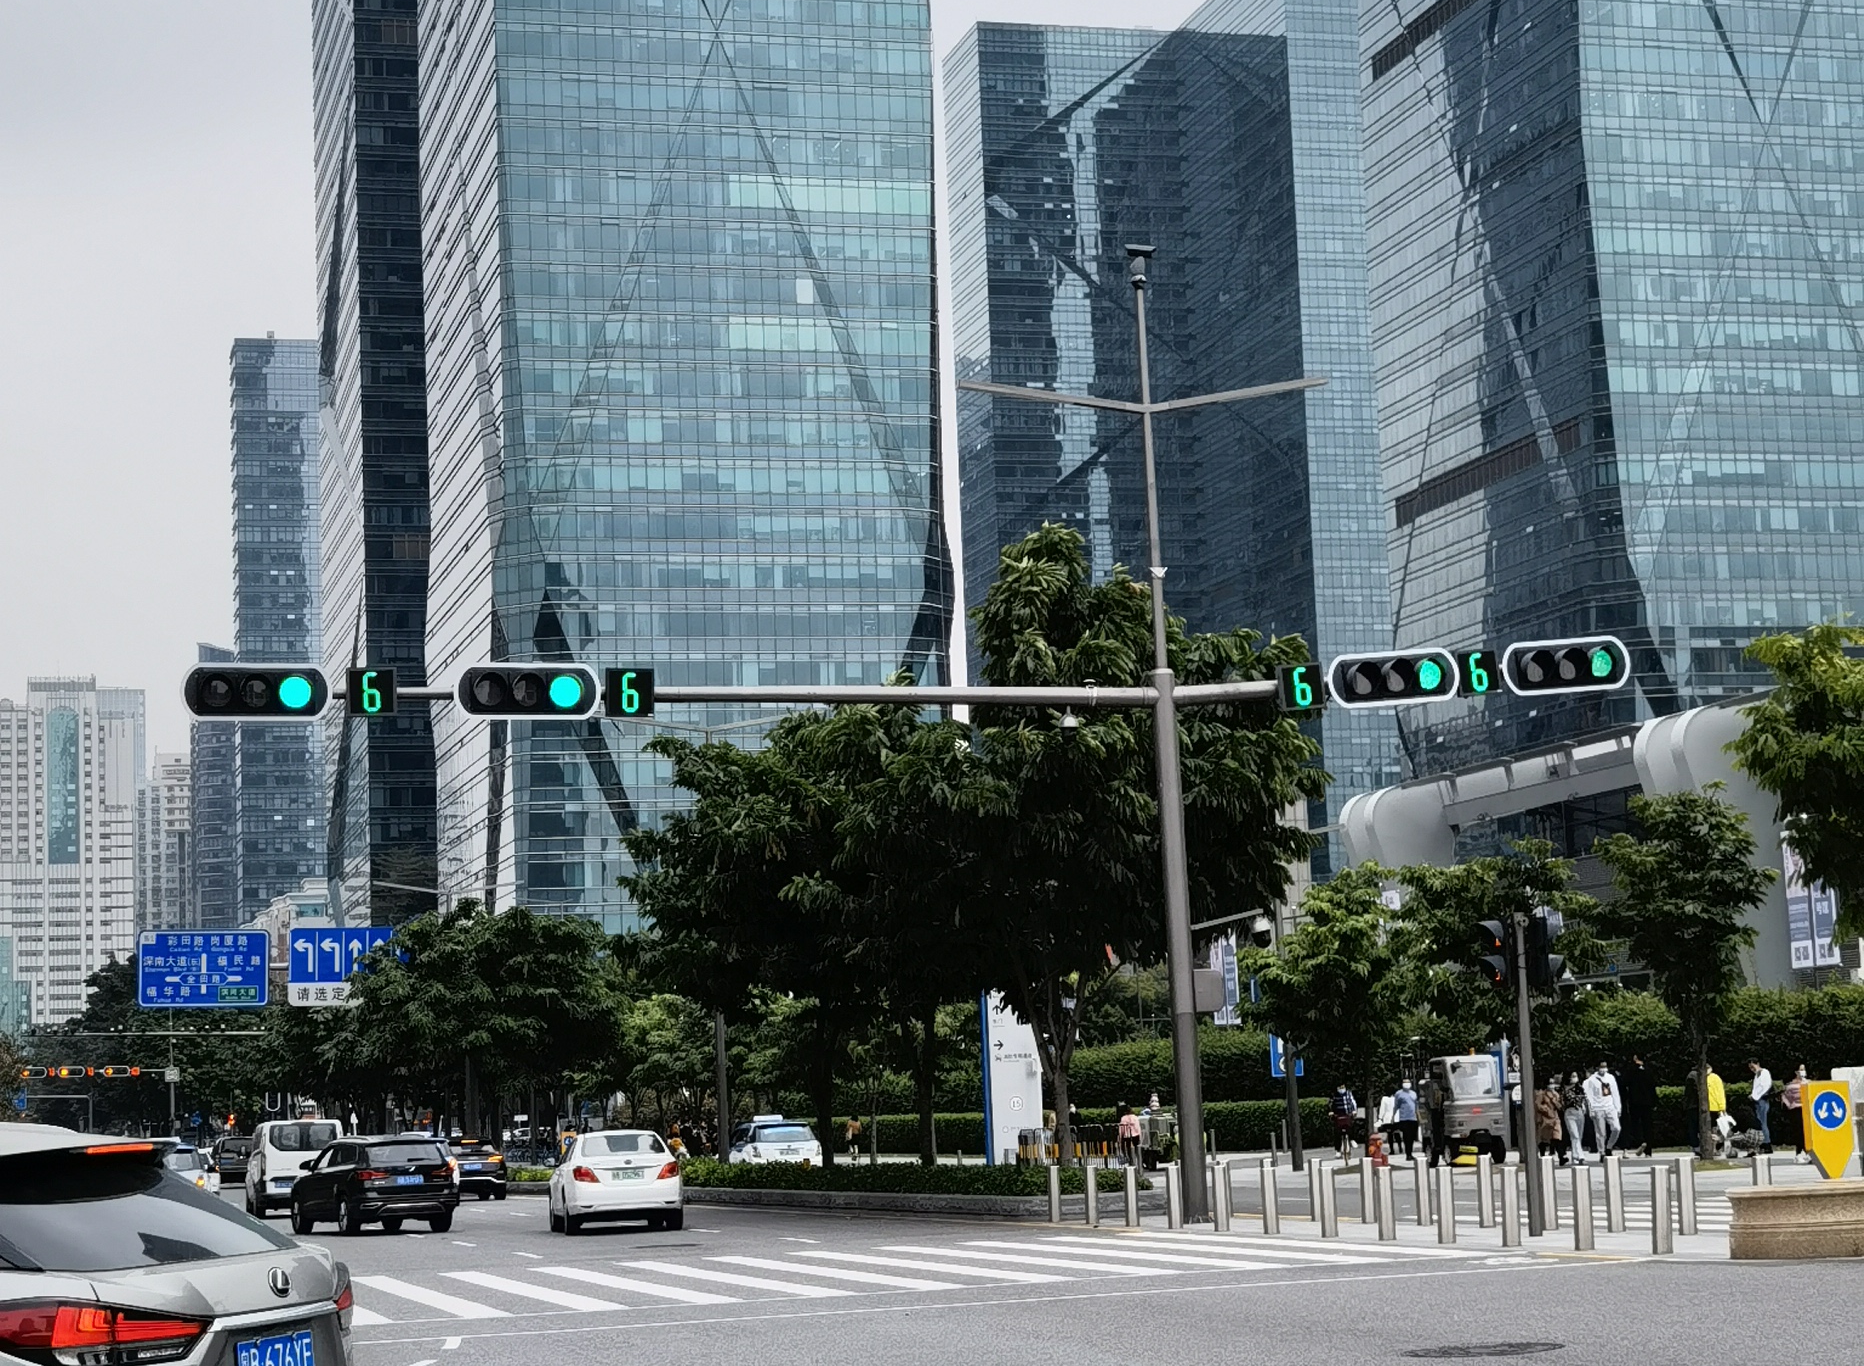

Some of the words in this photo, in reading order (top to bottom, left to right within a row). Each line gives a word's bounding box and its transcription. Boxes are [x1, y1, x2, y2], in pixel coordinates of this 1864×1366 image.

[362, 671, 382, 713] 6
[620, 671, 639, 713] 6
[1292, 666, 1313, 707] 6
[1468, 652, 1488, 693] 6
[167, 935, 204, 946] 彩田路
[217, 955, 260, 966] 福民路
[146, 986, 191, 997] 福华路
